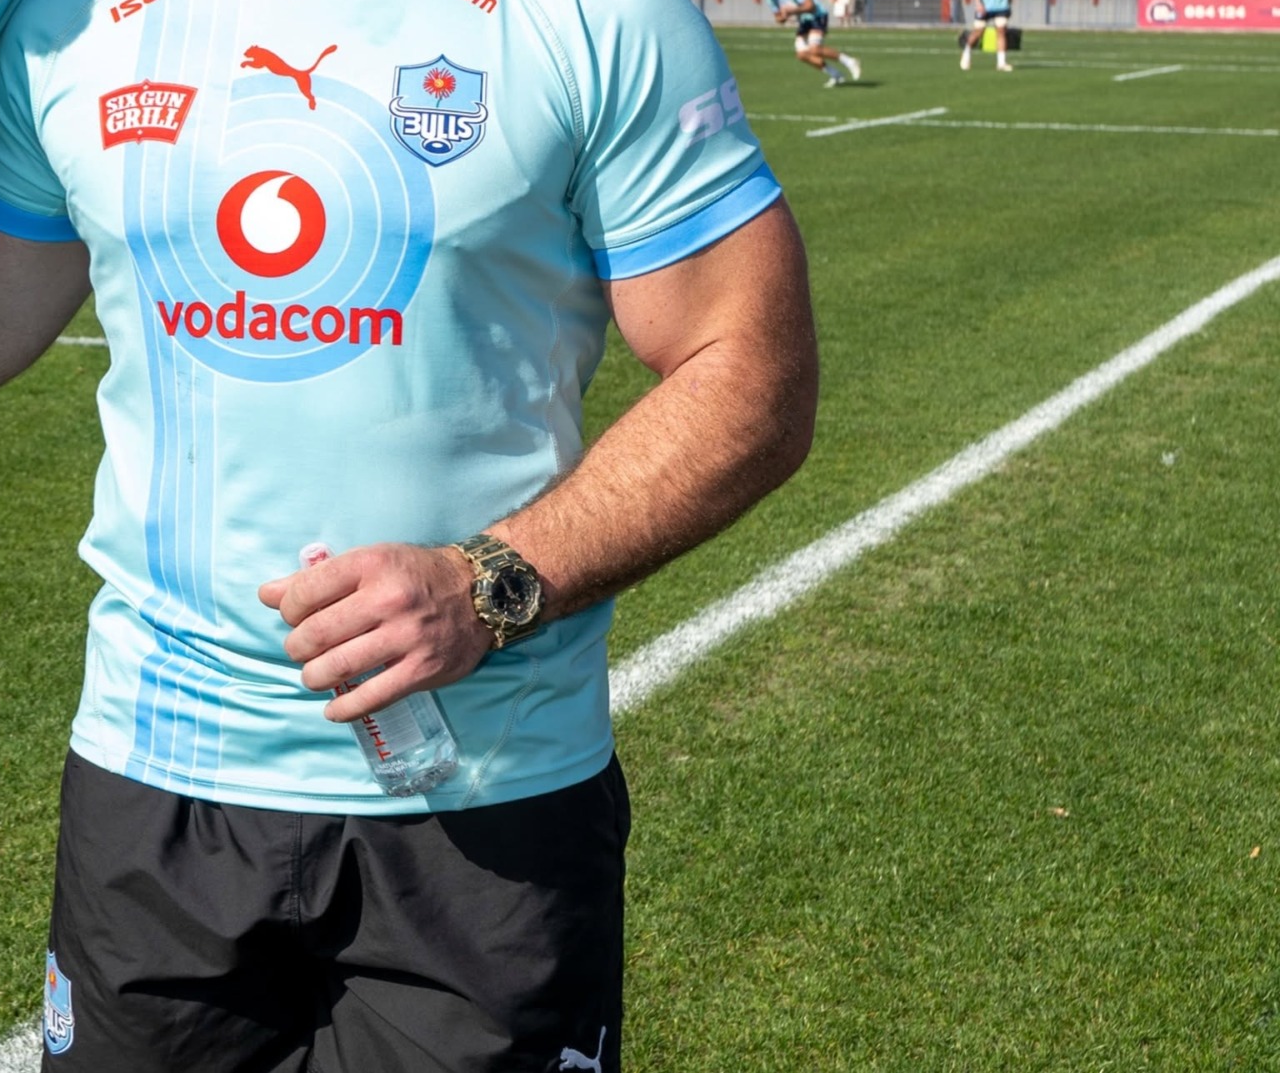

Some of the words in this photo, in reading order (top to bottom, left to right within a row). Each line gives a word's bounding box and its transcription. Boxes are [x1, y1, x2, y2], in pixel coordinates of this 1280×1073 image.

[105, 91, 140, 115] SIX
[139, 90, 187, 109] GUN
[105, 107, 179, 134] GRILL
[402, 112, 474, 142] BULLS
[157, 290, 403, 346] vodacom
